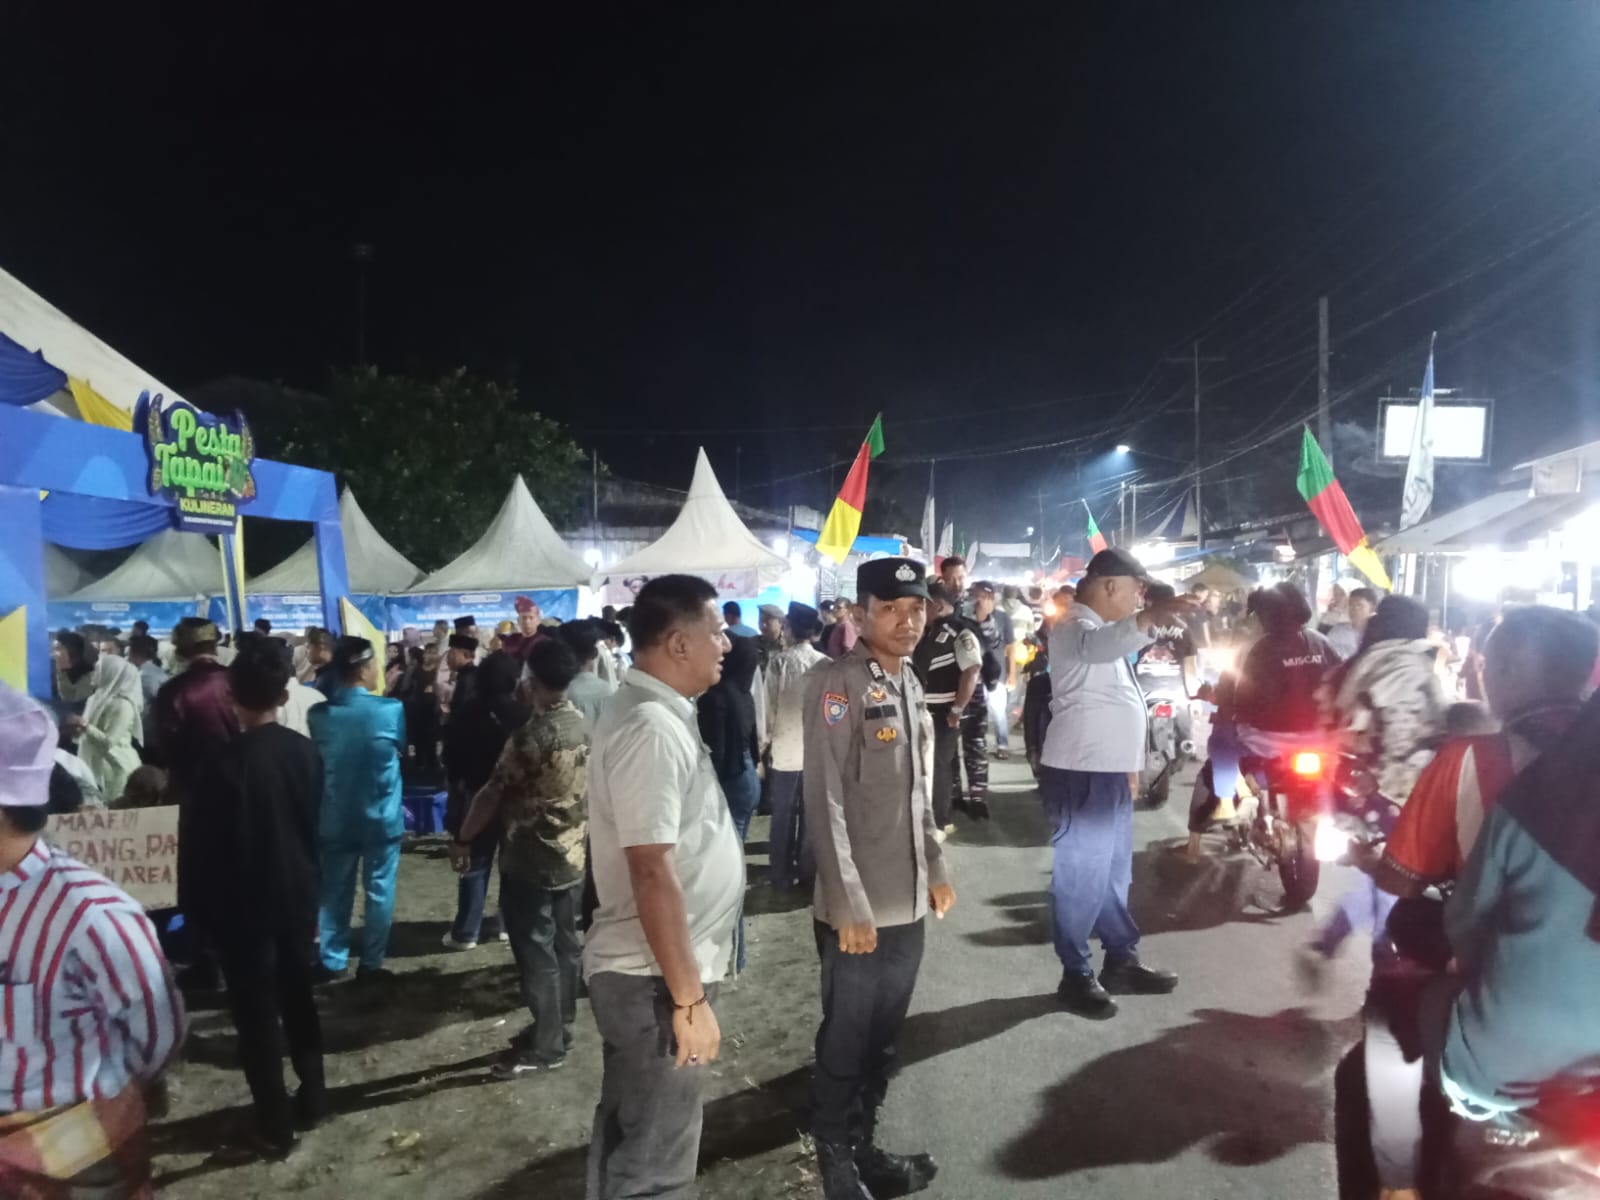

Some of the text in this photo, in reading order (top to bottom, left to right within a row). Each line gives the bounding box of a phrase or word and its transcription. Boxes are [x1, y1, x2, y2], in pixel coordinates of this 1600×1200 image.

[171, 408, 242, 458] Pesta
[155, 442, 229, 497] Tapai
[1282, 654, 1323, 668] MUSCAT
[145, 833, 177, 858] PA
[122, 865, 172, 884] AREA
